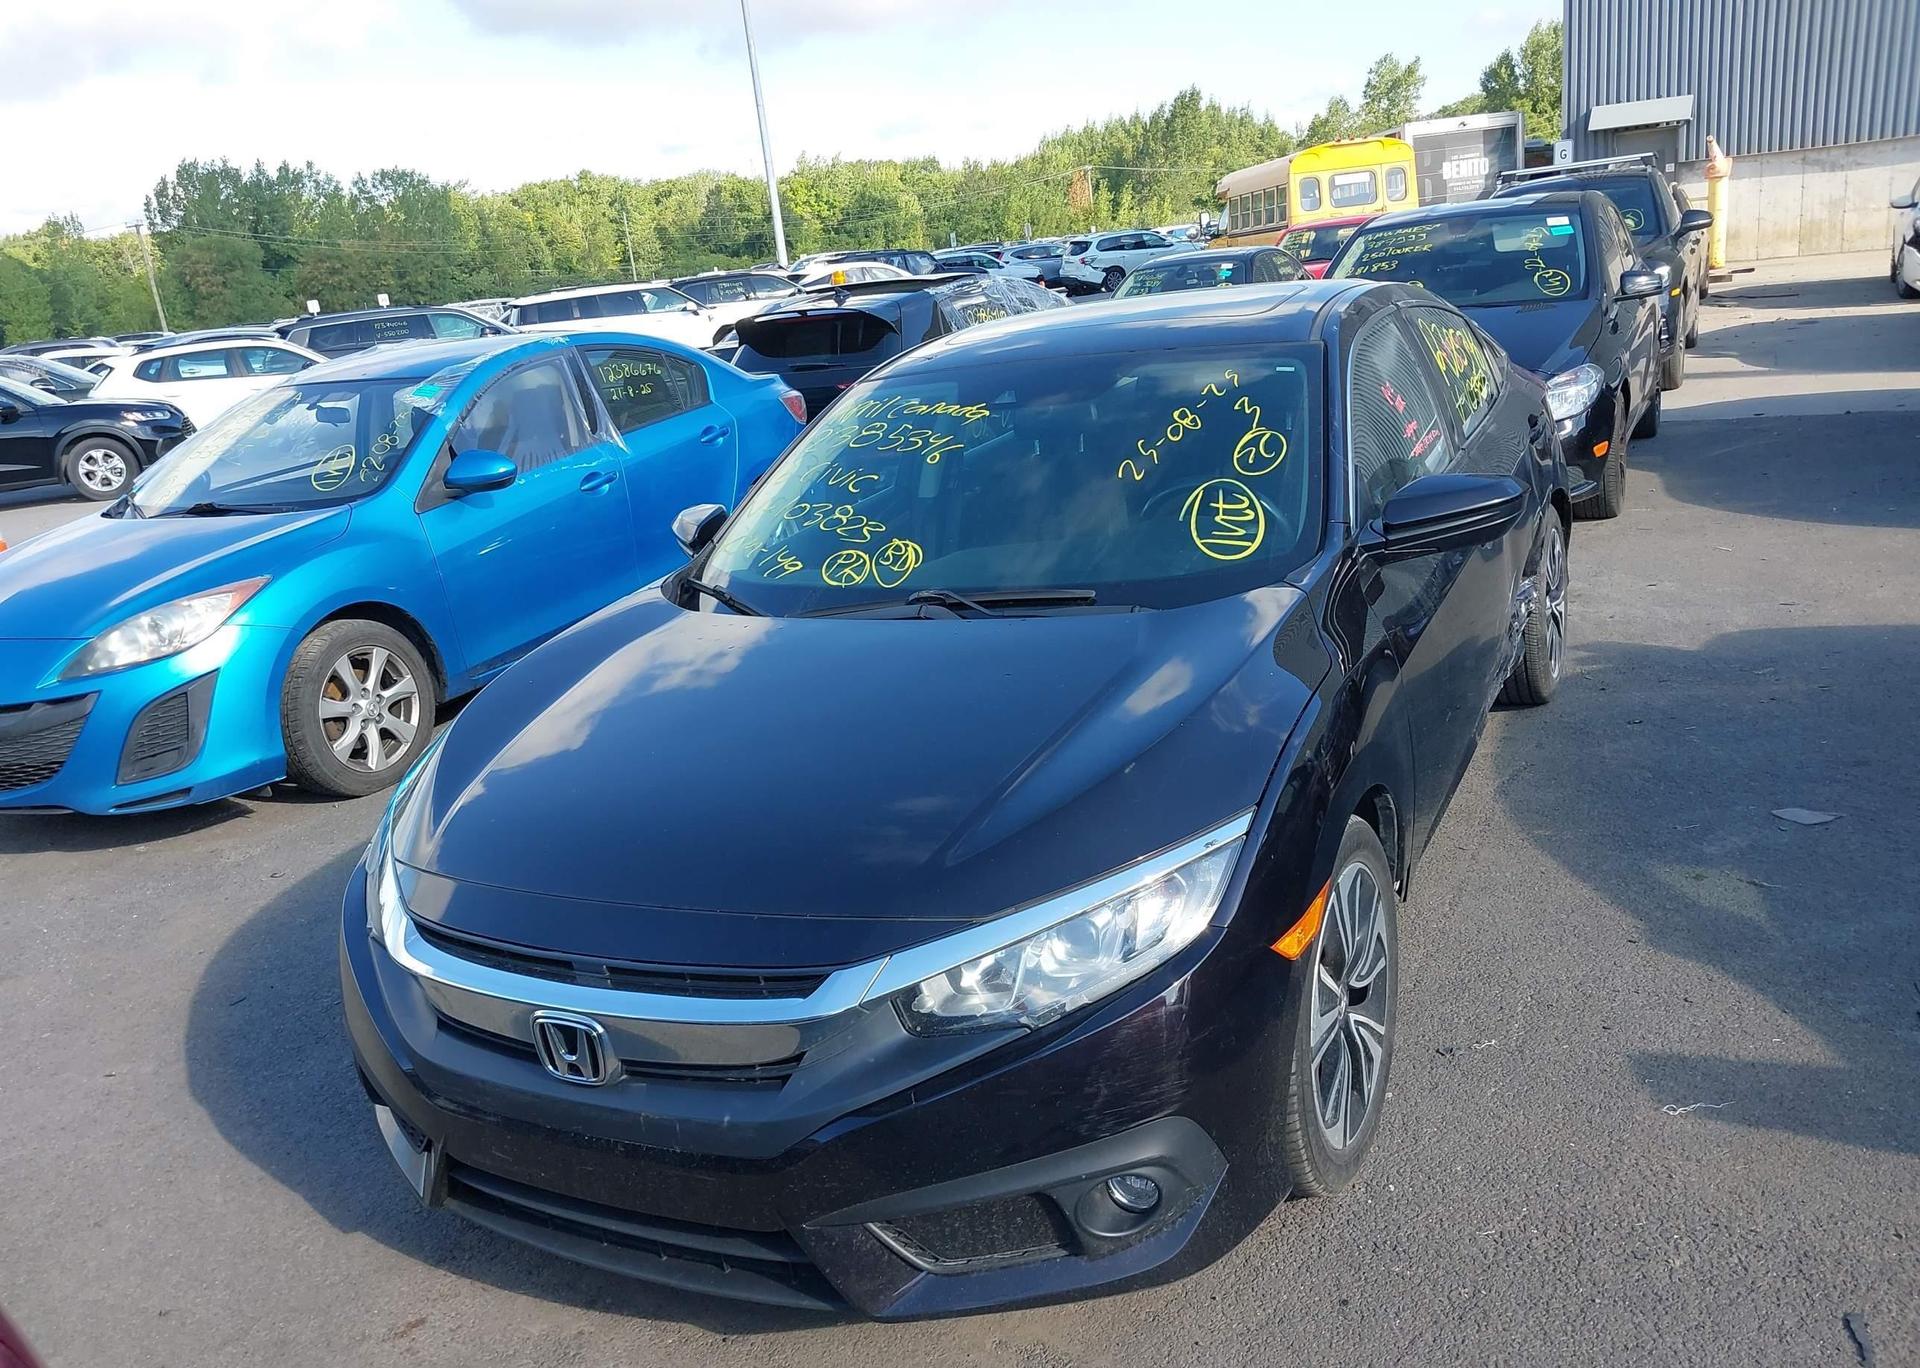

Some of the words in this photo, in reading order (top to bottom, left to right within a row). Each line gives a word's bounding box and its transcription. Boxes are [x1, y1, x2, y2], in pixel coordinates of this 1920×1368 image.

[1559, 149, 1568, 160] G
[1442, 157, 1489, 180] BENITO
[598, 362, 662, 384] 12386676
